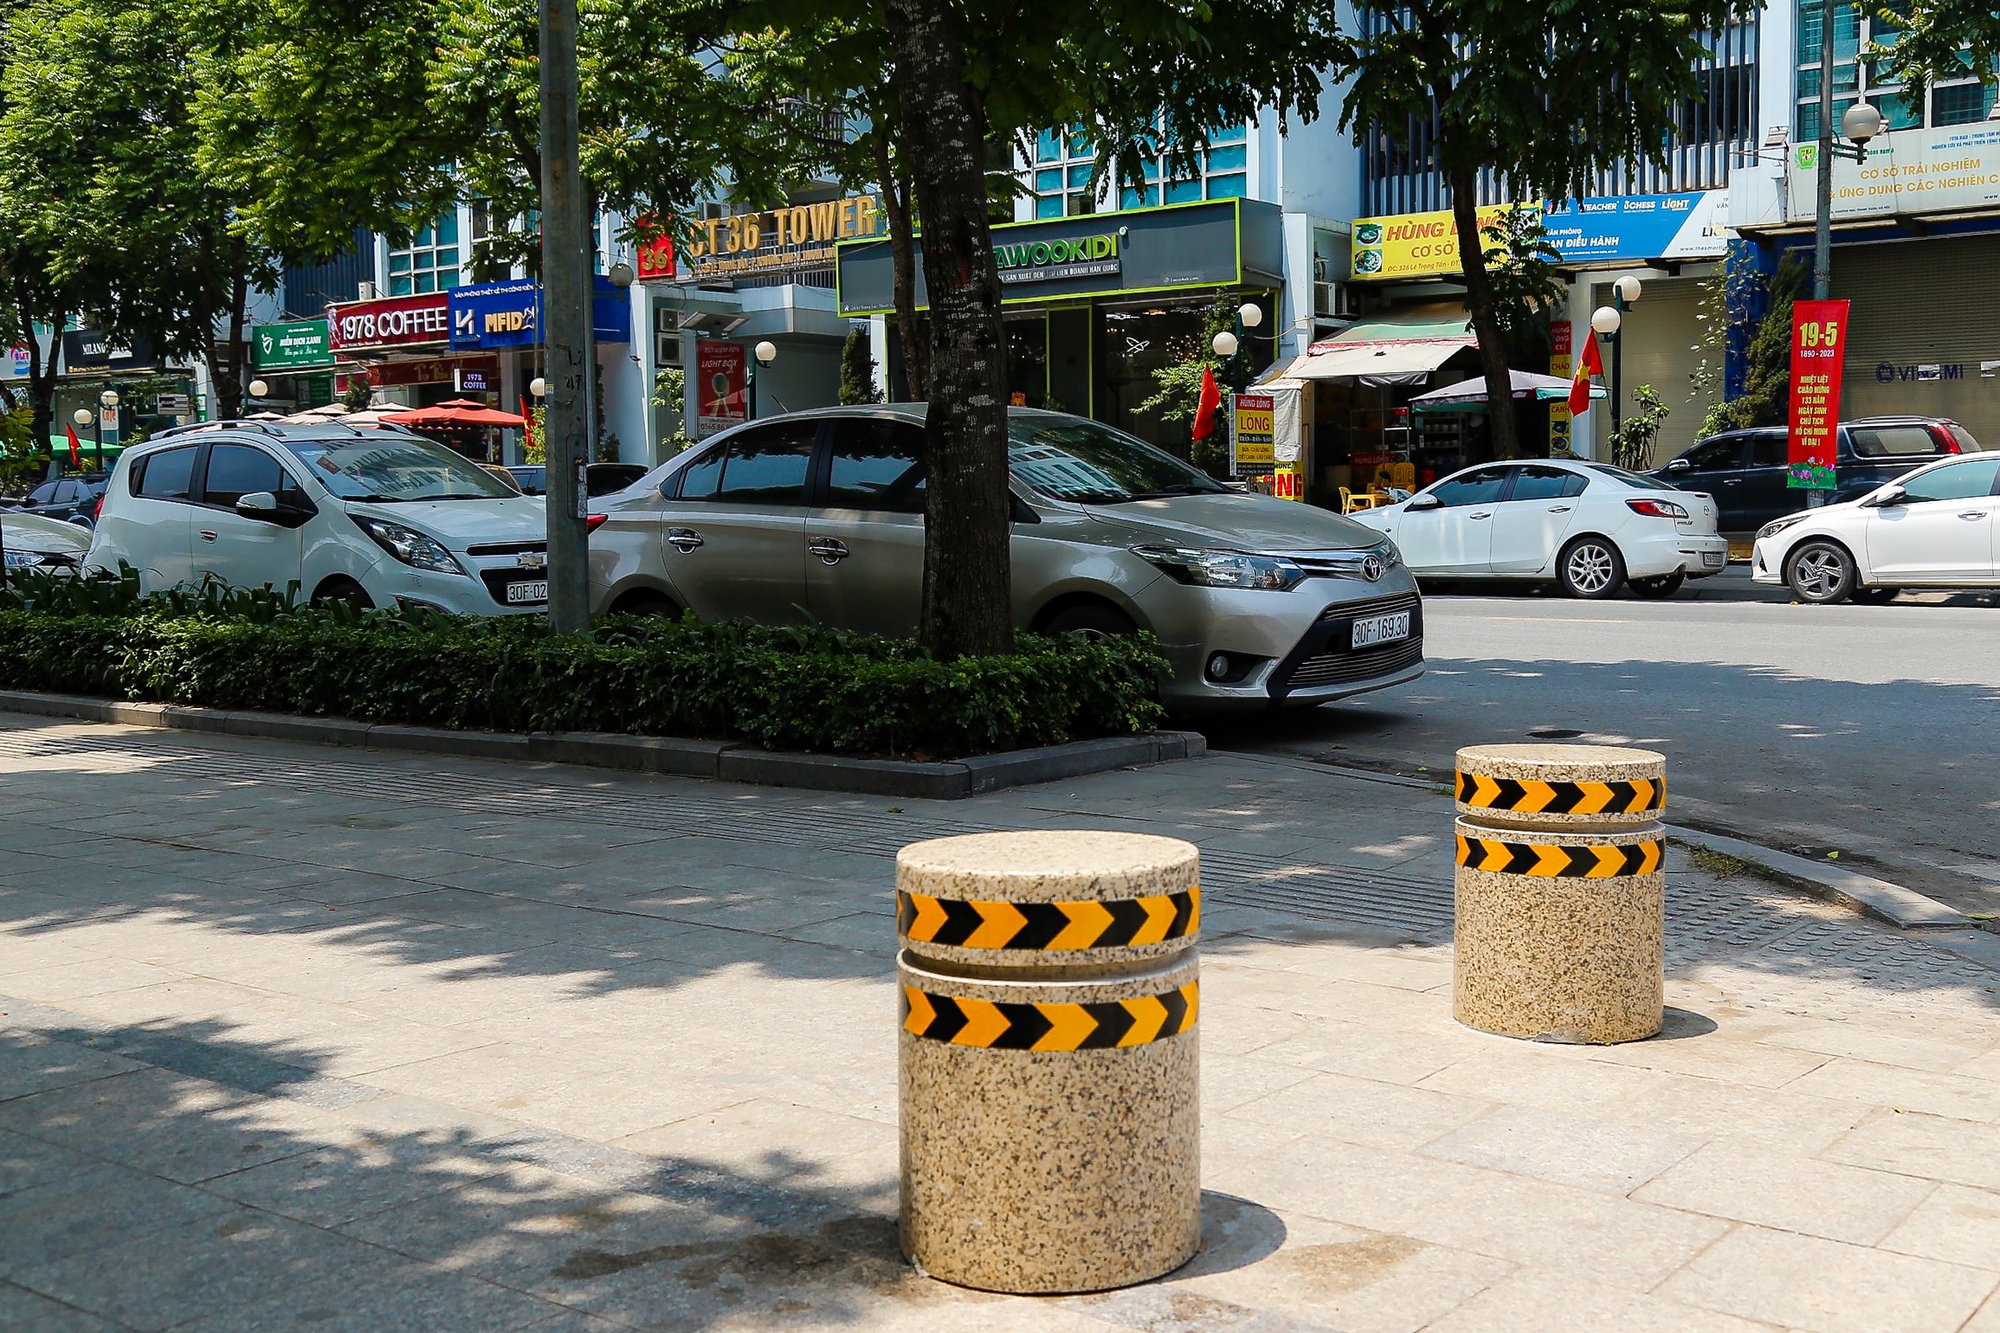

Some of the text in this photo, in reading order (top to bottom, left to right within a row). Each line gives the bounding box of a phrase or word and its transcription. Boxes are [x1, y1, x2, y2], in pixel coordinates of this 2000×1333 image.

[1860, 158, 1981, 180] CƠ SỞ TRẢI NGHIỆM
[1839, 187, 1865, 198] ỨNG
[1869, 184, 1903, 198] DỤNG
[1907, 179, 1935, 191] CÁC
[1939, 174, 1985, 189] NGHIÊN
[1661, 198, 1690, 209] LIGHT
[726, 212, 760, 254] 36
[774, 196, 877, 247] TOWER
[1387, 220, 1445, 242] HÙNG
[1411, 241, 1455, 258] CƠ SỞ
[1590, 234, 1620, 247] HÀNH
[643, 247, 668, 272] 36
[340, 307, 448, 341] 1978 COFFEE
[1800, 322, 1838, 347] 19-5
[1801, 350, 1815, 358] 1890
[1820, 349, 1835, 358] 2023
[464, 381, 487, 389] COFFEE
[1802, 397, 1812, 405] 133
[1814, 407, 1827, 415] SINH
[1241, 412, 1270, 431] LÒNG
[1814, 428, 1829, 436] MINH
[1271, 474, 1303, 497] NG
